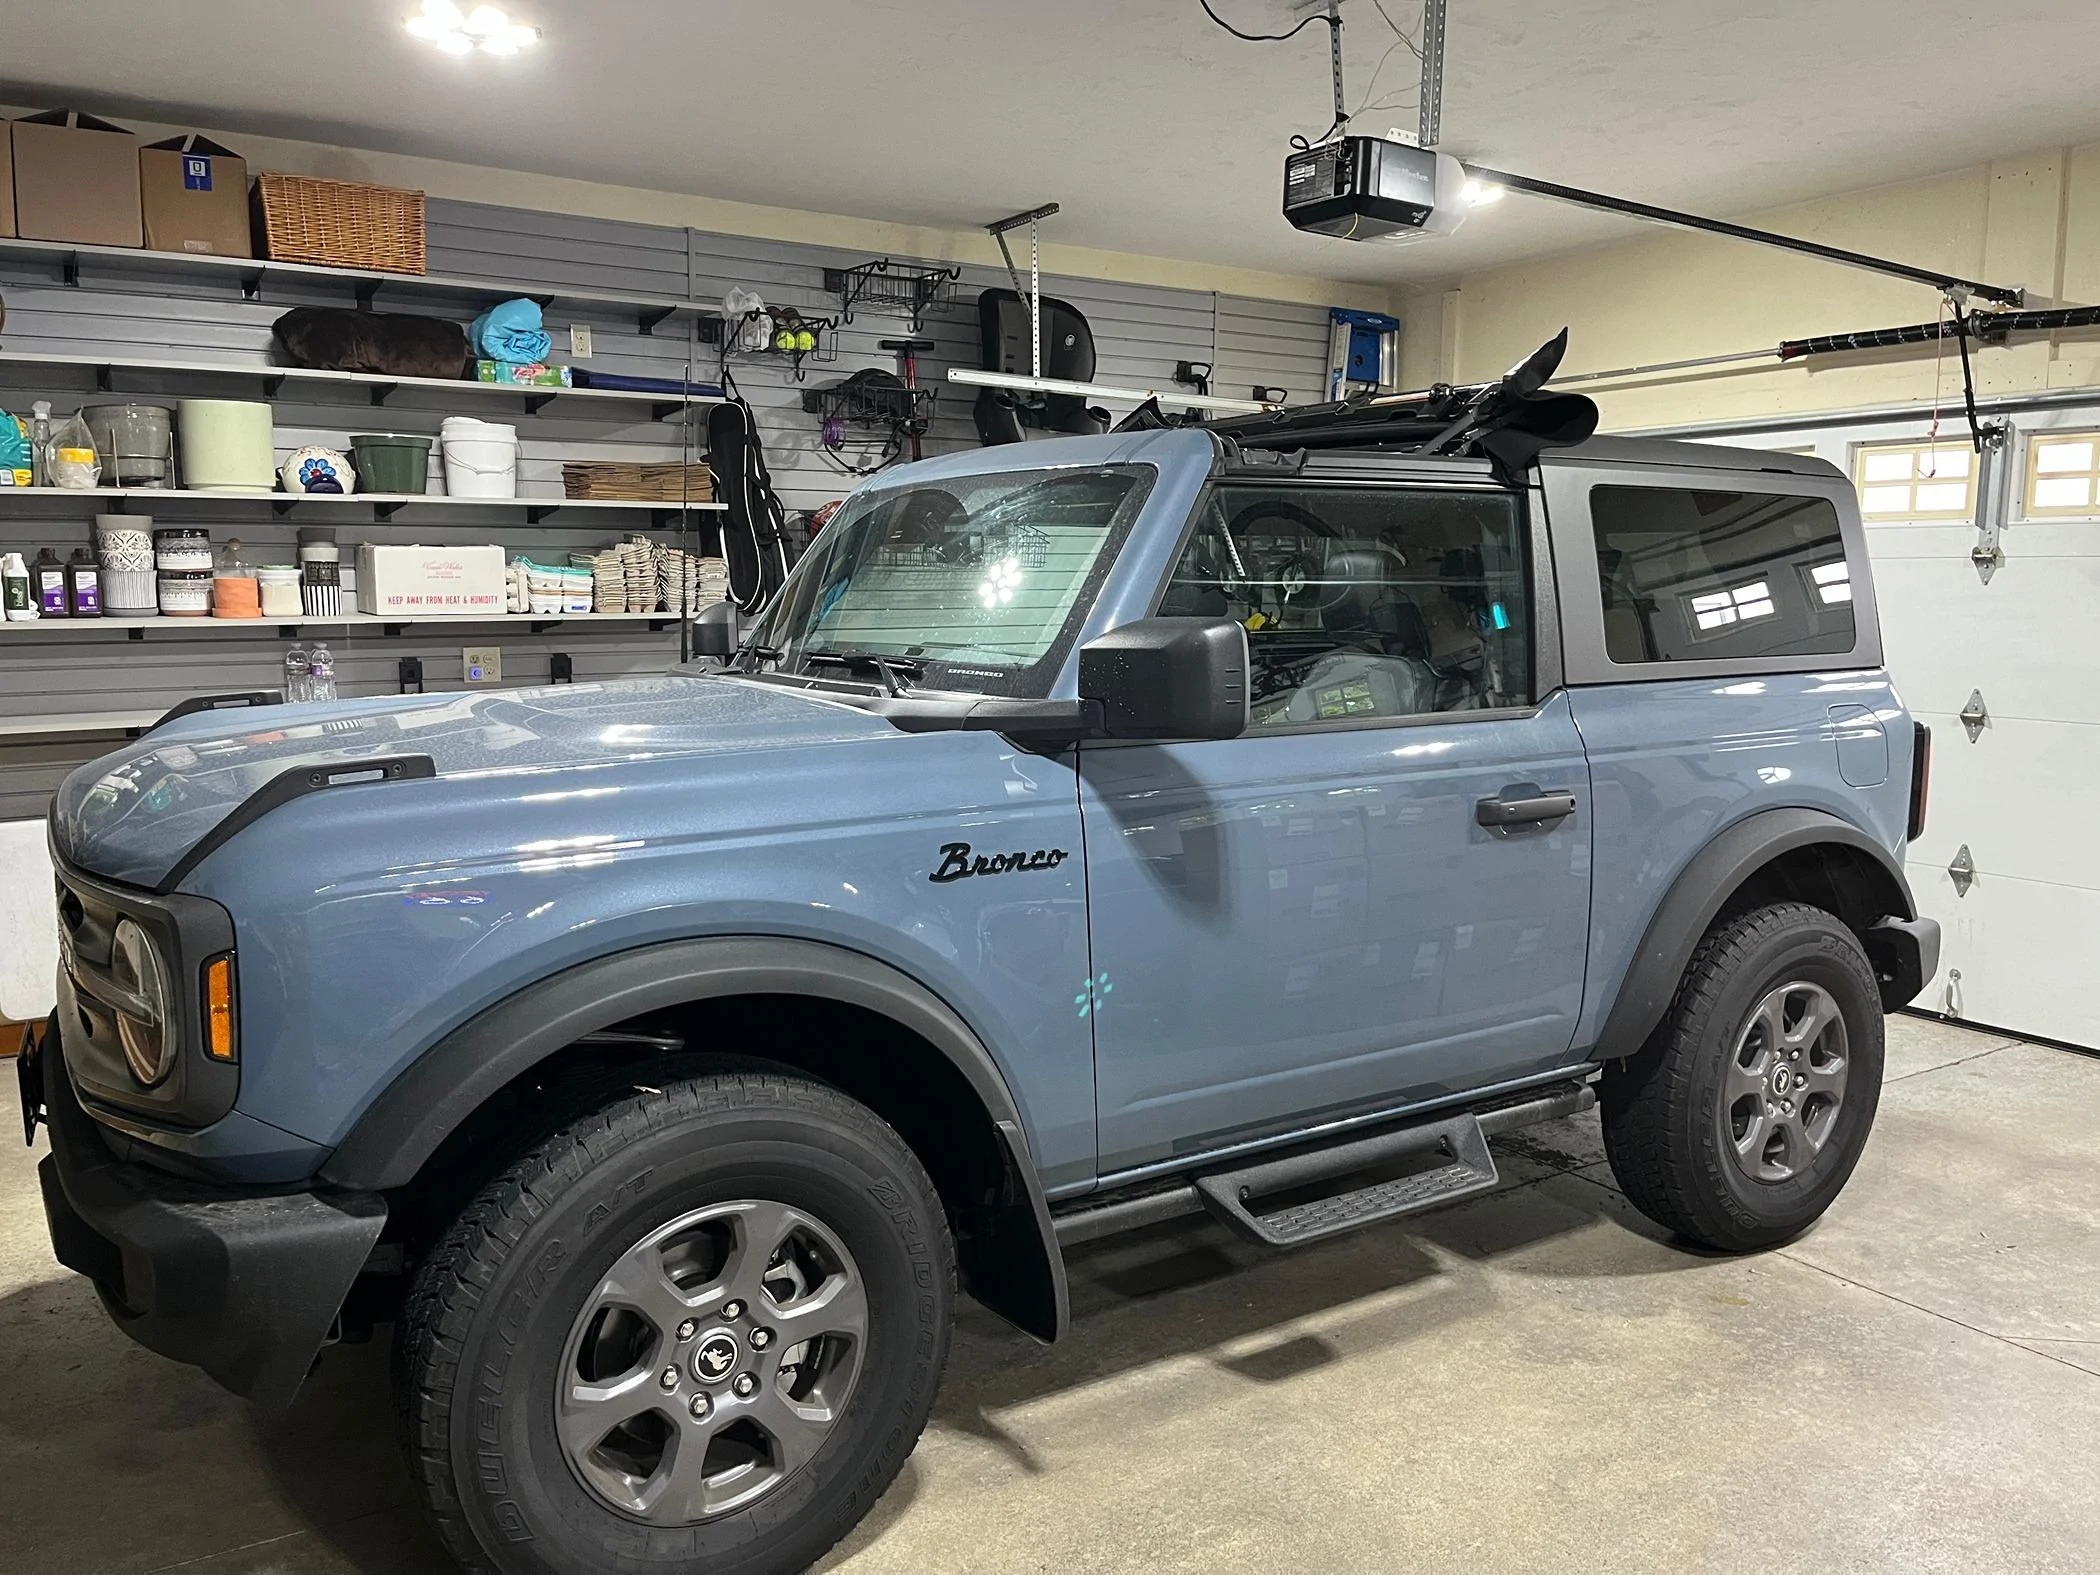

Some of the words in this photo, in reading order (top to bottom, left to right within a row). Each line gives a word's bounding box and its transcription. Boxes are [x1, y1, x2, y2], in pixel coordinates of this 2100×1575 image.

[388, 596, 403, 605] KEEP
[406, 596, 423, 605] AWAY
[426, 596, 443, 605] FROM
[445, 595, 461, 604] HEAT
[463, 596, 468, 604] &
[470, 595, 498, 604] HUMIDITY
[947, 668, 1004, 678] BRONCO
[929, 842, 1069, 883] Bronco
[584, 1166, 656, 1237] A/T
